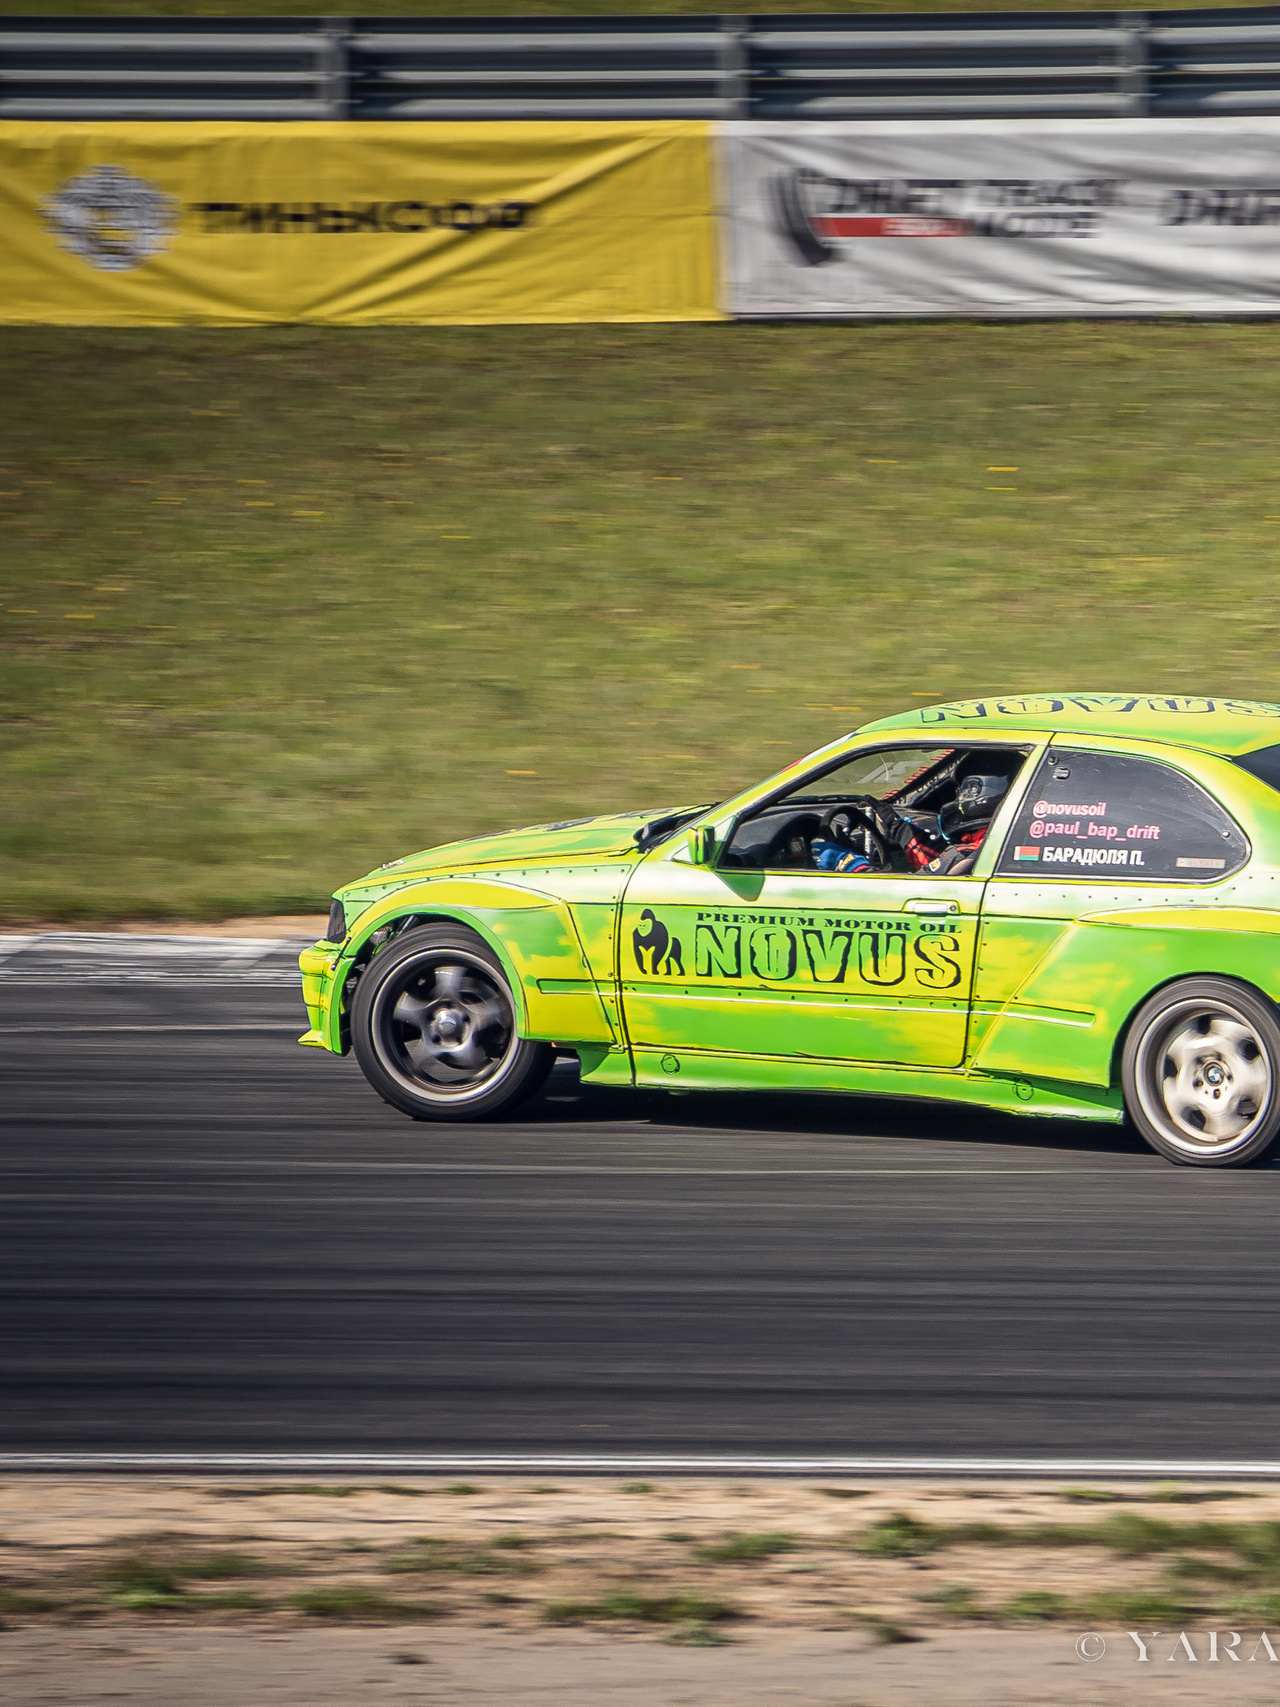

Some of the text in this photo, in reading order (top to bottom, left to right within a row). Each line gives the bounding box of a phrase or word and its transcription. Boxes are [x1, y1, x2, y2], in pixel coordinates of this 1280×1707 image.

[1032, 800, 1107, 819] @novusoil
[1029, 820, 1161, 842] @paul_bap_drift
[1042, 846, 1146, 866] БАРАДЮЛЯ П.
[696, 911, 963, 935] PREMIUM MOTOR OIL
[695, 923, 963, 990] NOVUS
